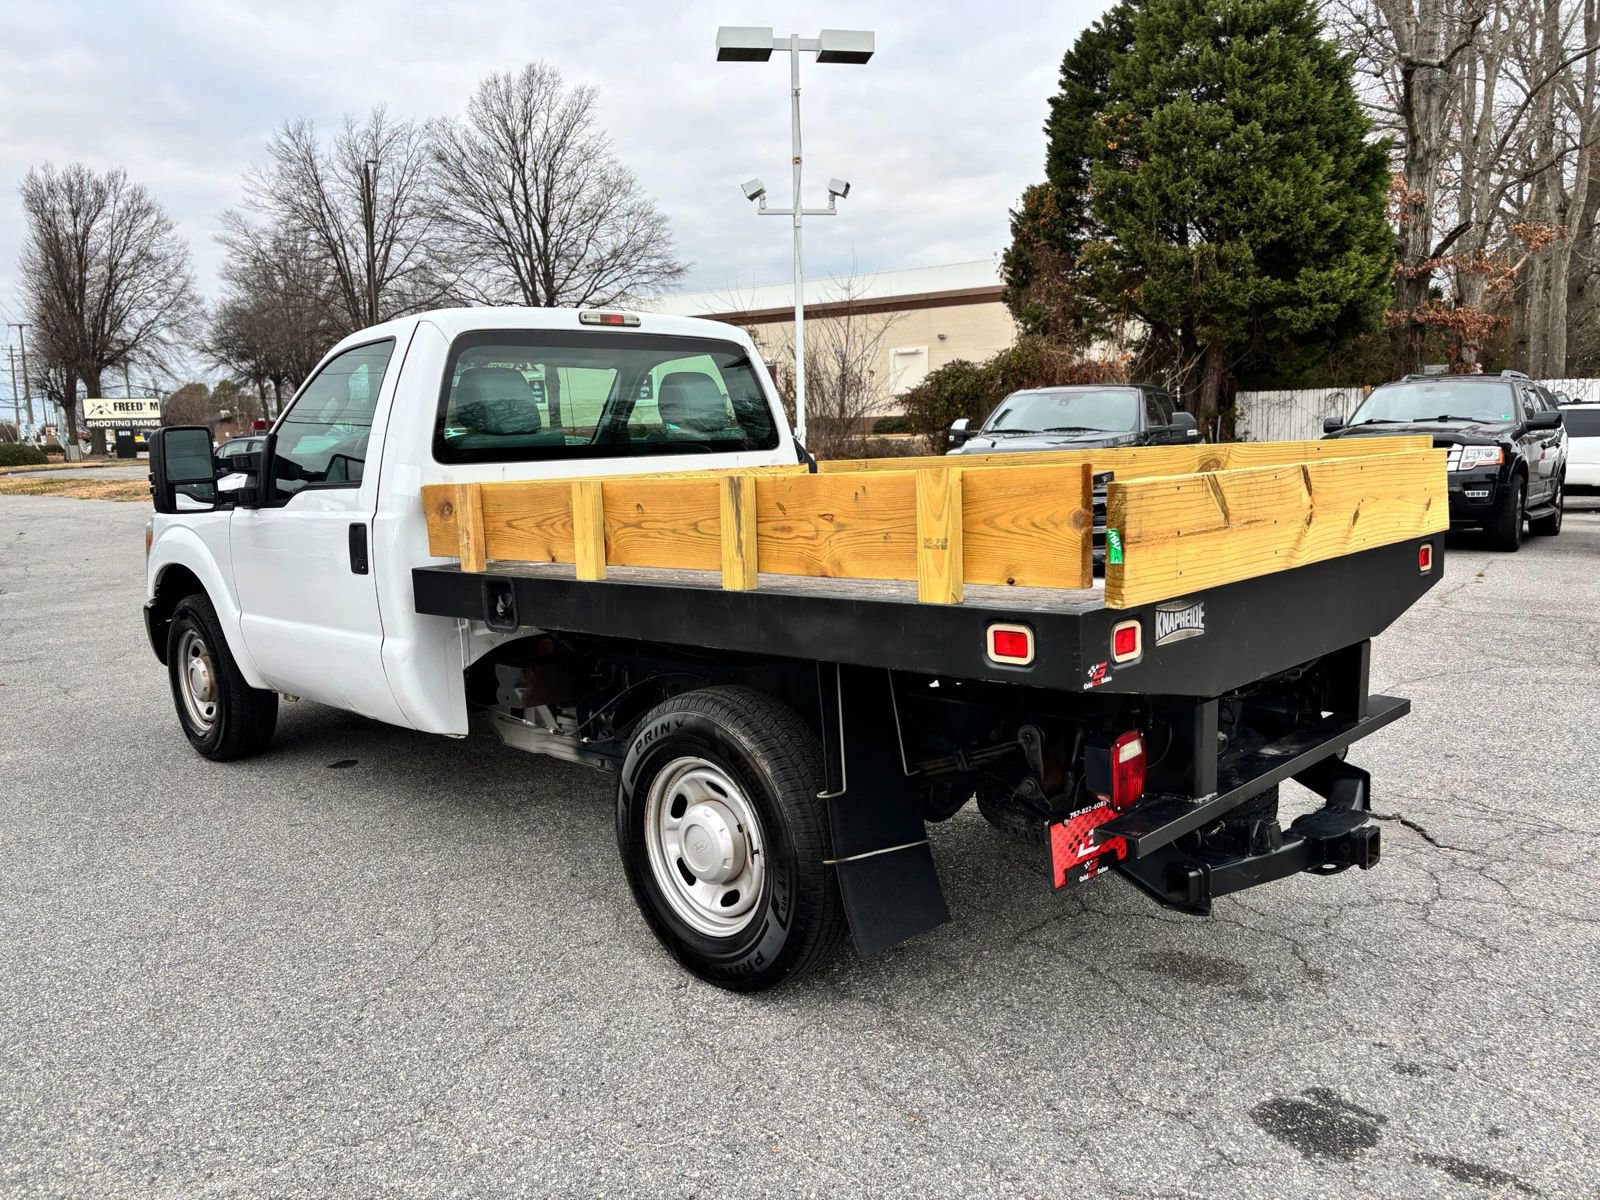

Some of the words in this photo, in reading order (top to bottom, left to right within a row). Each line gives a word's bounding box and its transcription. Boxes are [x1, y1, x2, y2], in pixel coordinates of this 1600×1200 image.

[86, 419, 131, 428] SHOOTING
[131, 419, 161, 427] RANGE
[1155, 600, 1205, 641] KNAPHEIDE
